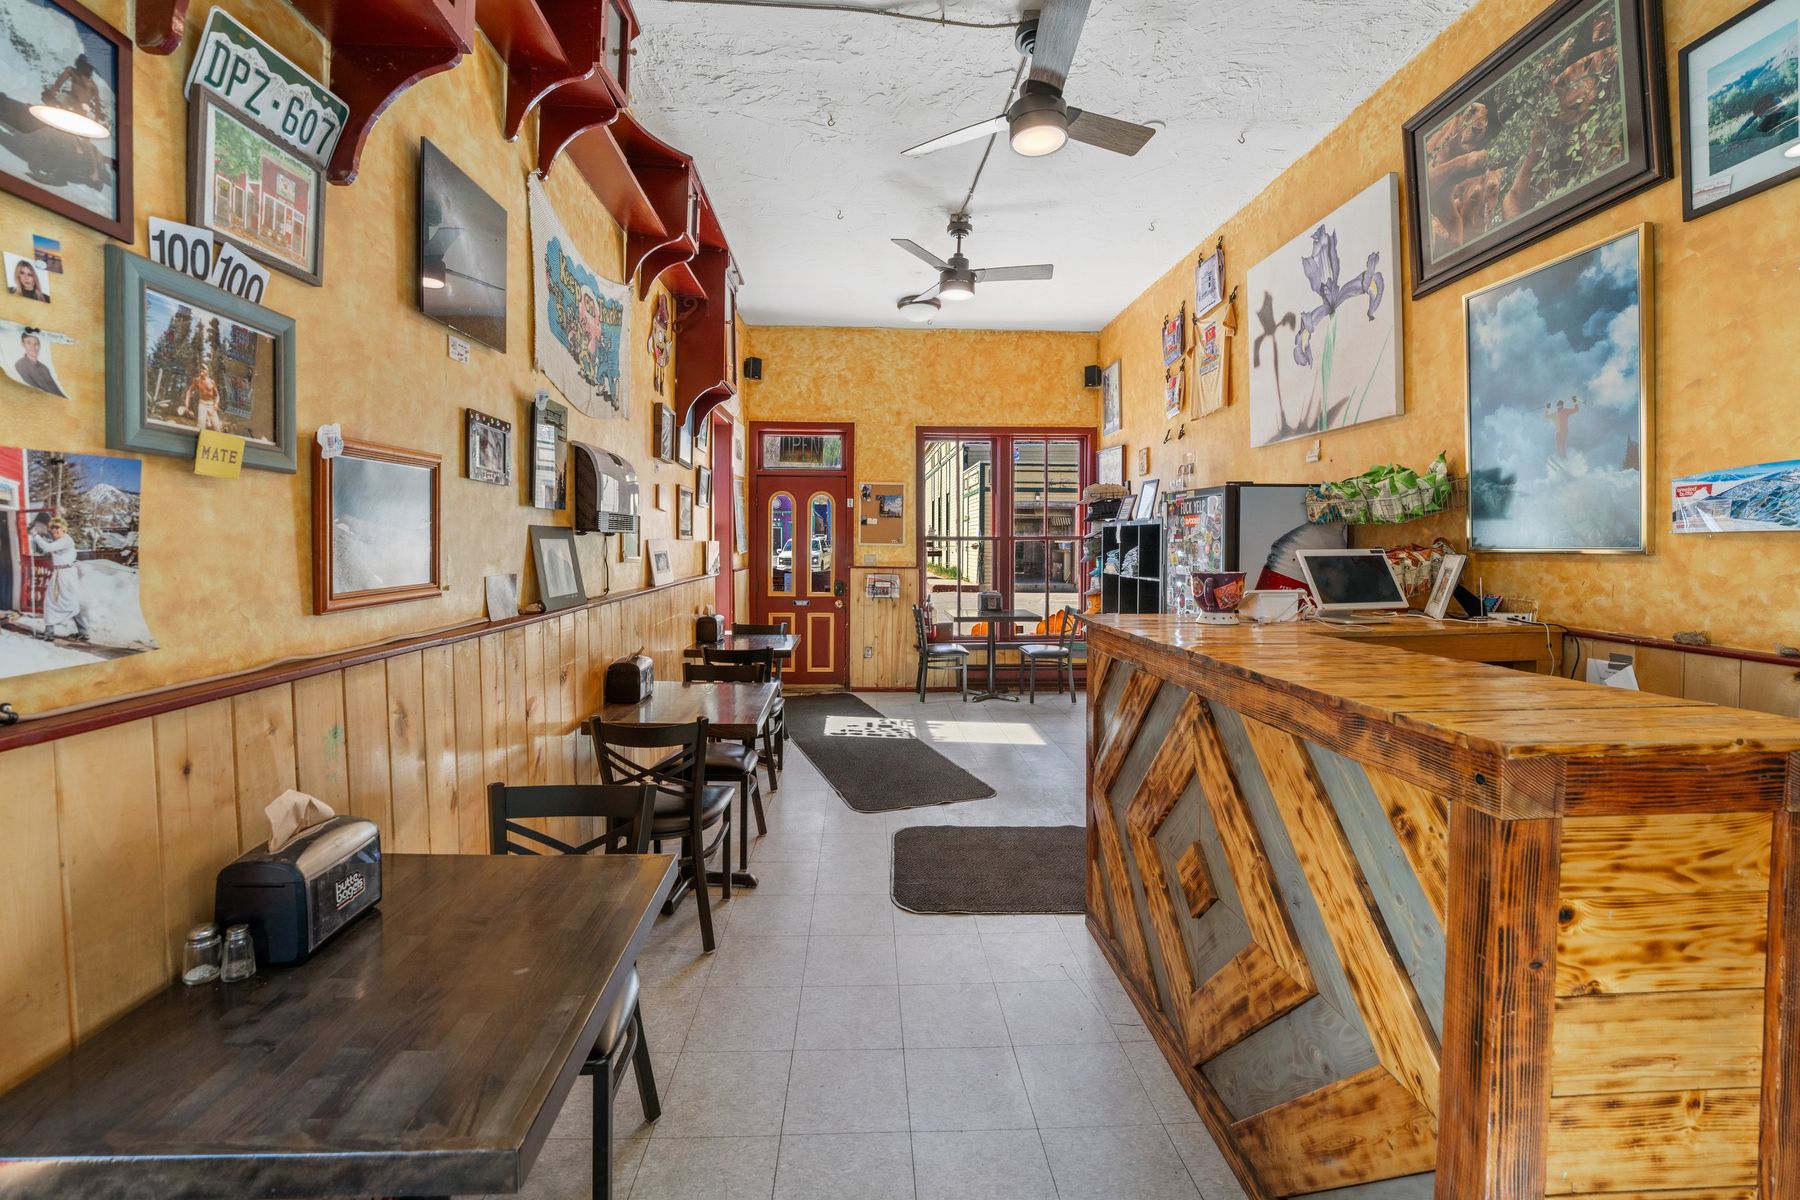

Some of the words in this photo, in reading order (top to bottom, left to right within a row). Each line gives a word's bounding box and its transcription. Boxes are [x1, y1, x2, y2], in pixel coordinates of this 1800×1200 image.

[151, 229, 210, 281] 100
[220, 255, 264, 304] 100
[201, 445, 238, 464] MATE
[782, 436, 821, 462] OPEN
[1193, 500, 1206, 514] YELP
[335, 873, 360, 894] butte
